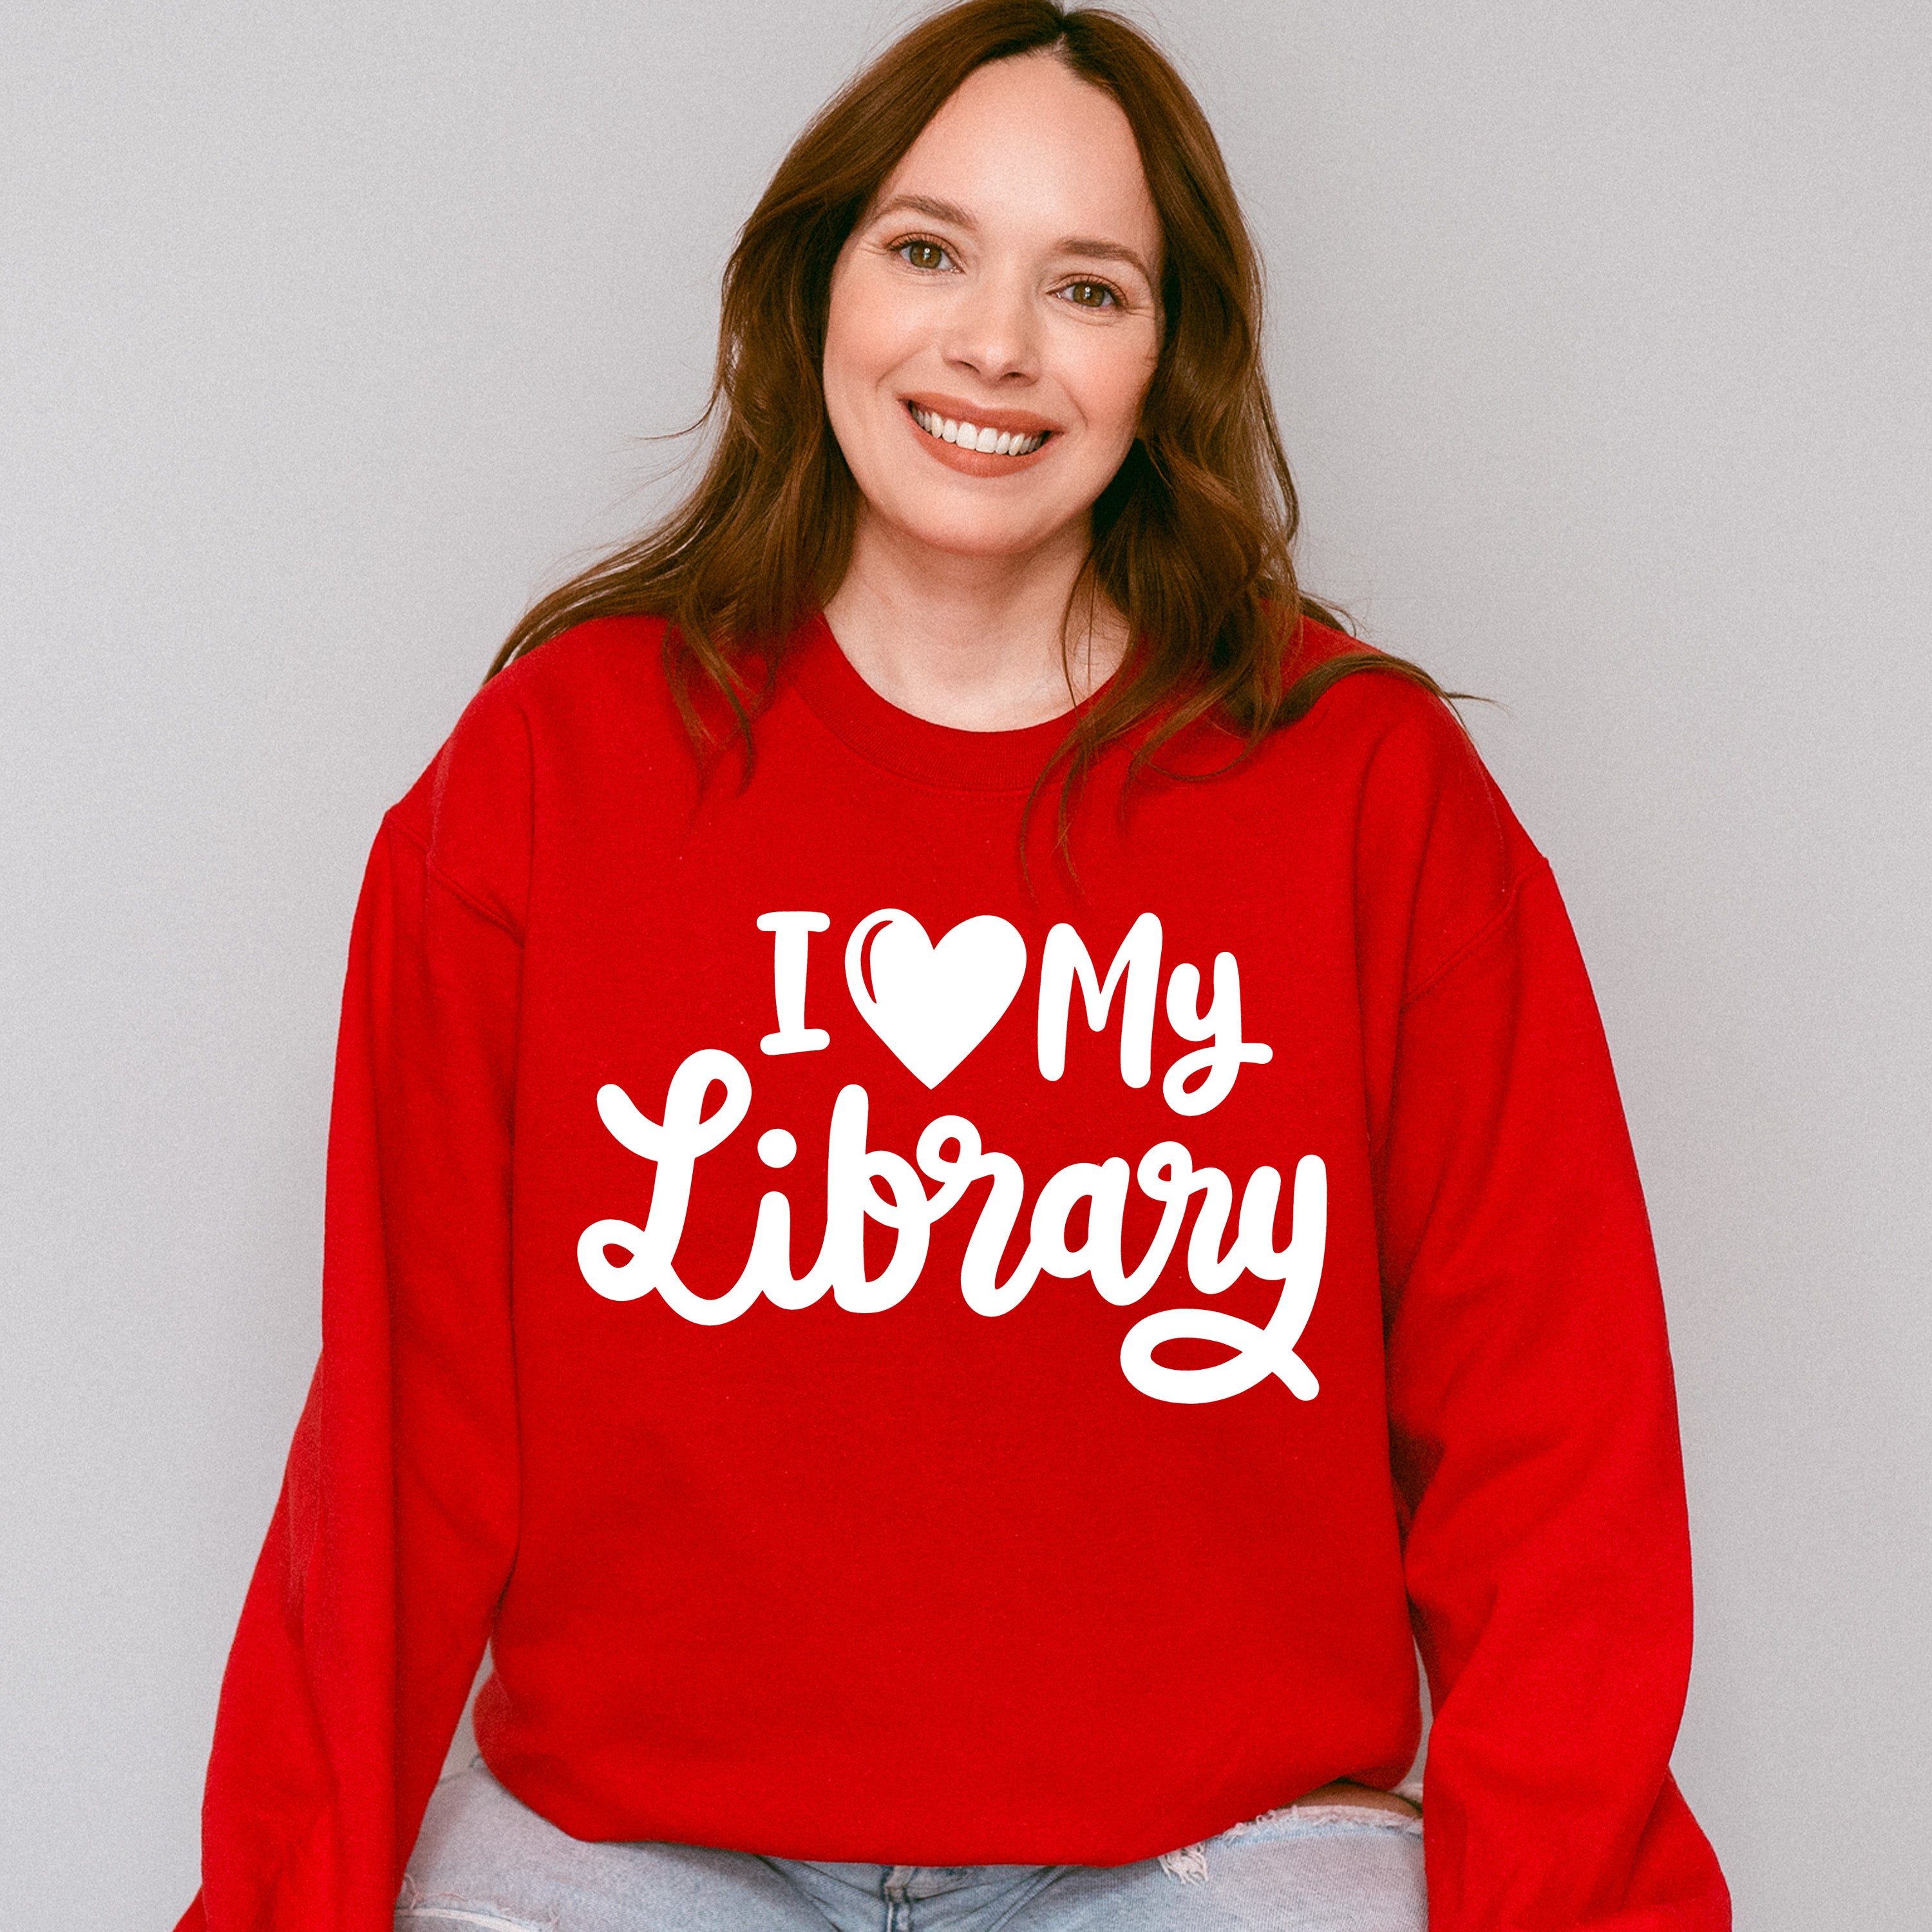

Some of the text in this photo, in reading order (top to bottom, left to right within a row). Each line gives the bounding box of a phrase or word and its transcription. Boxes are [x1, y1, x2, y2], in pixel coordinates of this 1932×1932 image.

[757, 911, 1273, 1116] I My
[577, 1049, 1327, 1404] Library
